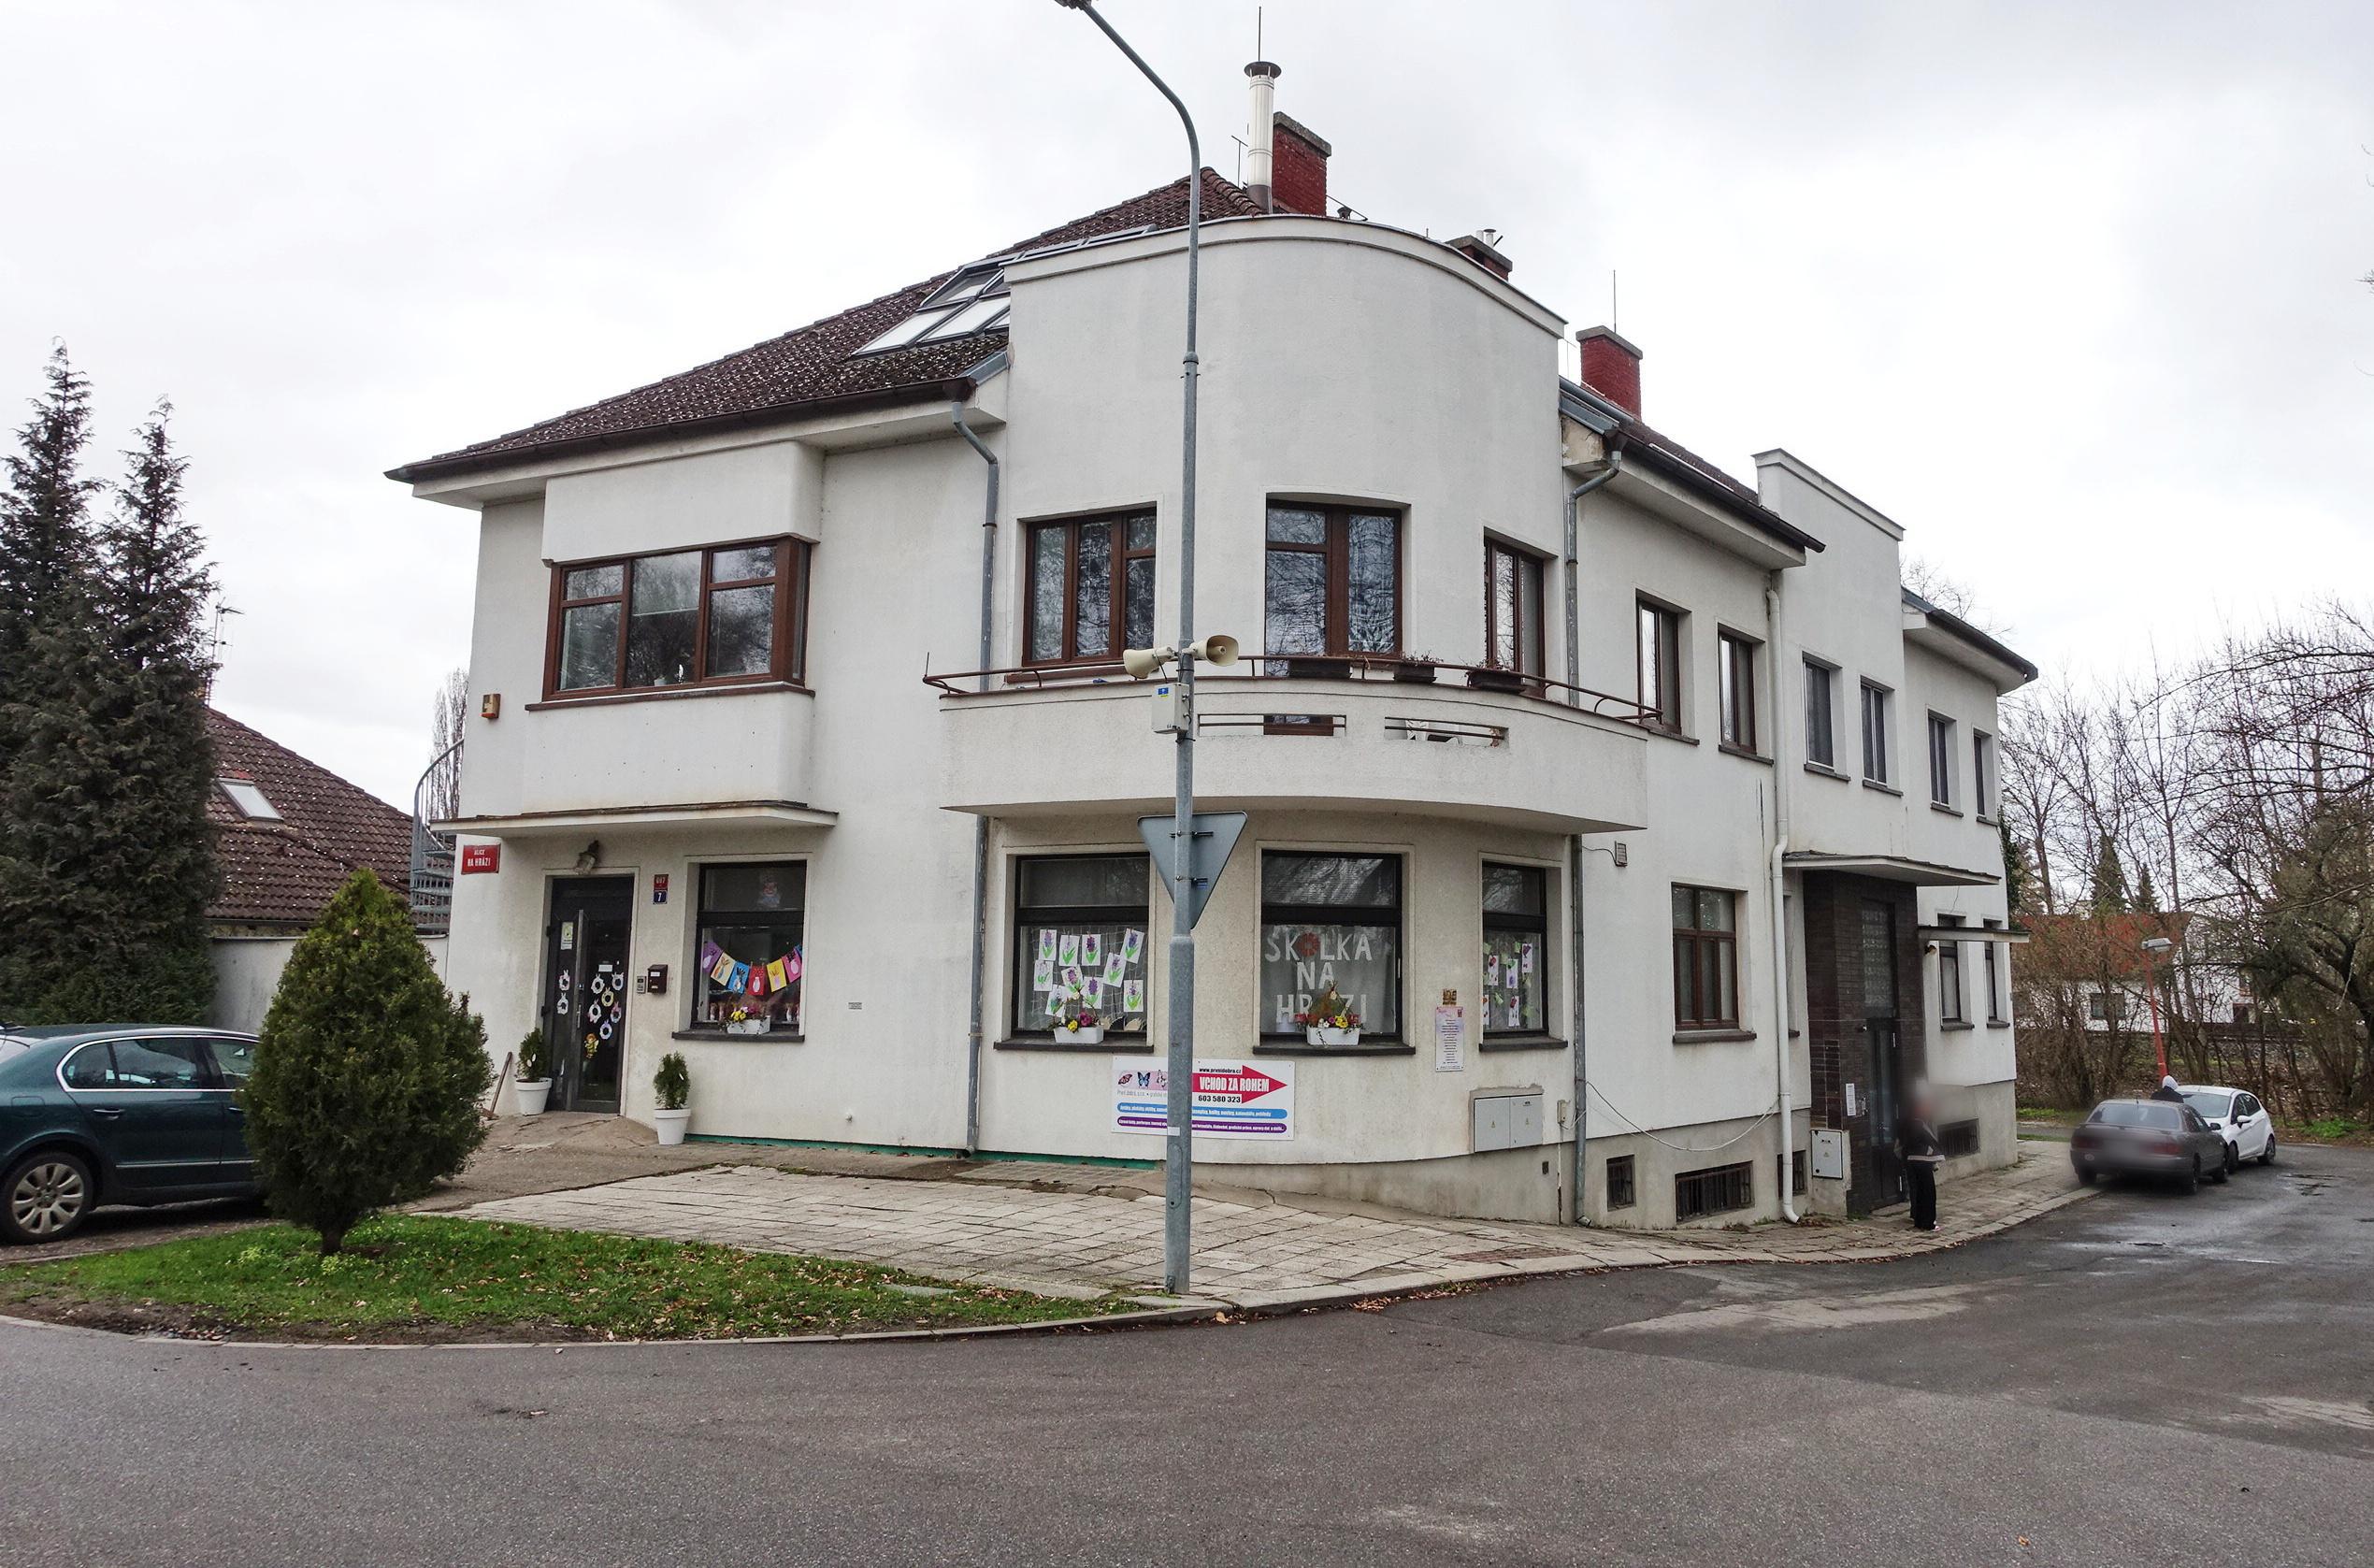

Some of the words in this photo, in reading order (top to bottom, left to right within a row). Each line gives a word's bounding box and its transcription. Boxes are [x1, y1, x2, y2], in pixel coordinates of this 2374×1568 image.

[468, 857, 474, 867] NA
[475, 856, 491, 867] HRÁZI
[1296, 961, 1335, 990] NA
[1275, 994, 1367, 1024] HRZI
[1200, 1076, 1227, 1091] VCHOD
[1228, 1078, 1239, 1091] ZA
[1240, 1078, 1270, 1092] ROHEM
